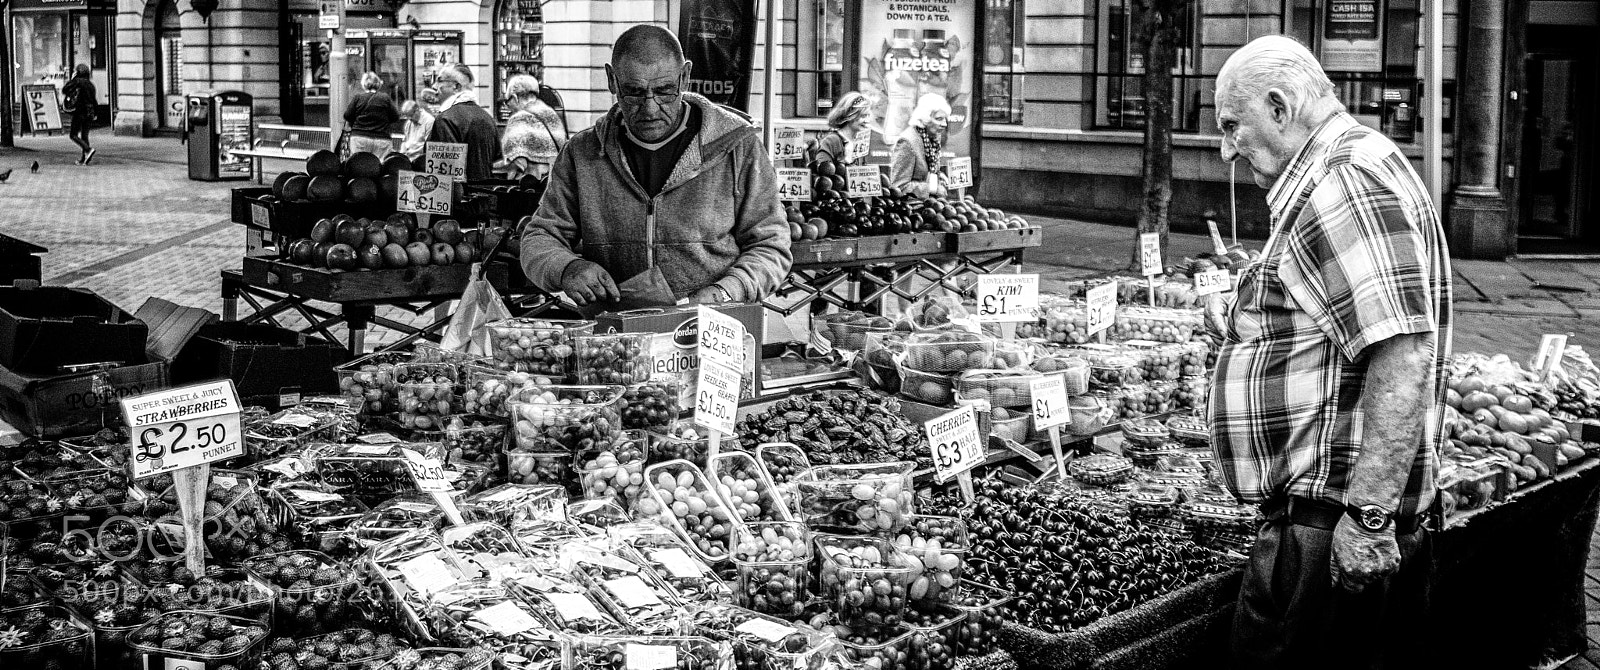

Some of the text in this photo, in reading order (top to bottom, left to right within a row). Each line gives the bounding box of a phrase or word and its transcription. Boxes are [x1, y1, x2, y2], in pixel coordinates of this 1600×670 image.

[886, 13, 913, 21] DOWN
[897, 4, 950, 13] BOTANICALS.
[1332, 4, 1375, 12] CASH ISA
[884, 52, 949, 71] fuzetea
[31, 92, 49, 129] SALE
[778, 131, 802, 139] LEMONS
[432, 152, 461, 160] ORANGES
[997, 285, 1023, 296] KIWI
[980, 294, 1007, 316] £1
[1090, 307, 1101, 326] £1
[708, 321, 736, 340] DATES
[701, 330, 732, 357] £2.50
[704, 374, 728, 390] SEEDLESS
[131, 400, 160, 412] SUPER
[161, 394, 191, 406] SWEET
[202, 387, 223, 398] JUICY
[718, 389, 737, 403] GRAPES
[136, 398, 228, 425] STRAWBERRIES
[1035, 398, 1051, 420] £1
[930, 410, 971, 438] CHERRIES
[136, 423, 226, 463] £2.50
[203, 442, 237, 460] PUNNET
[937, 441, 962, 472] £3
[959, 429, 977, 449] HALF
[967, 443, 978, 459] LB
